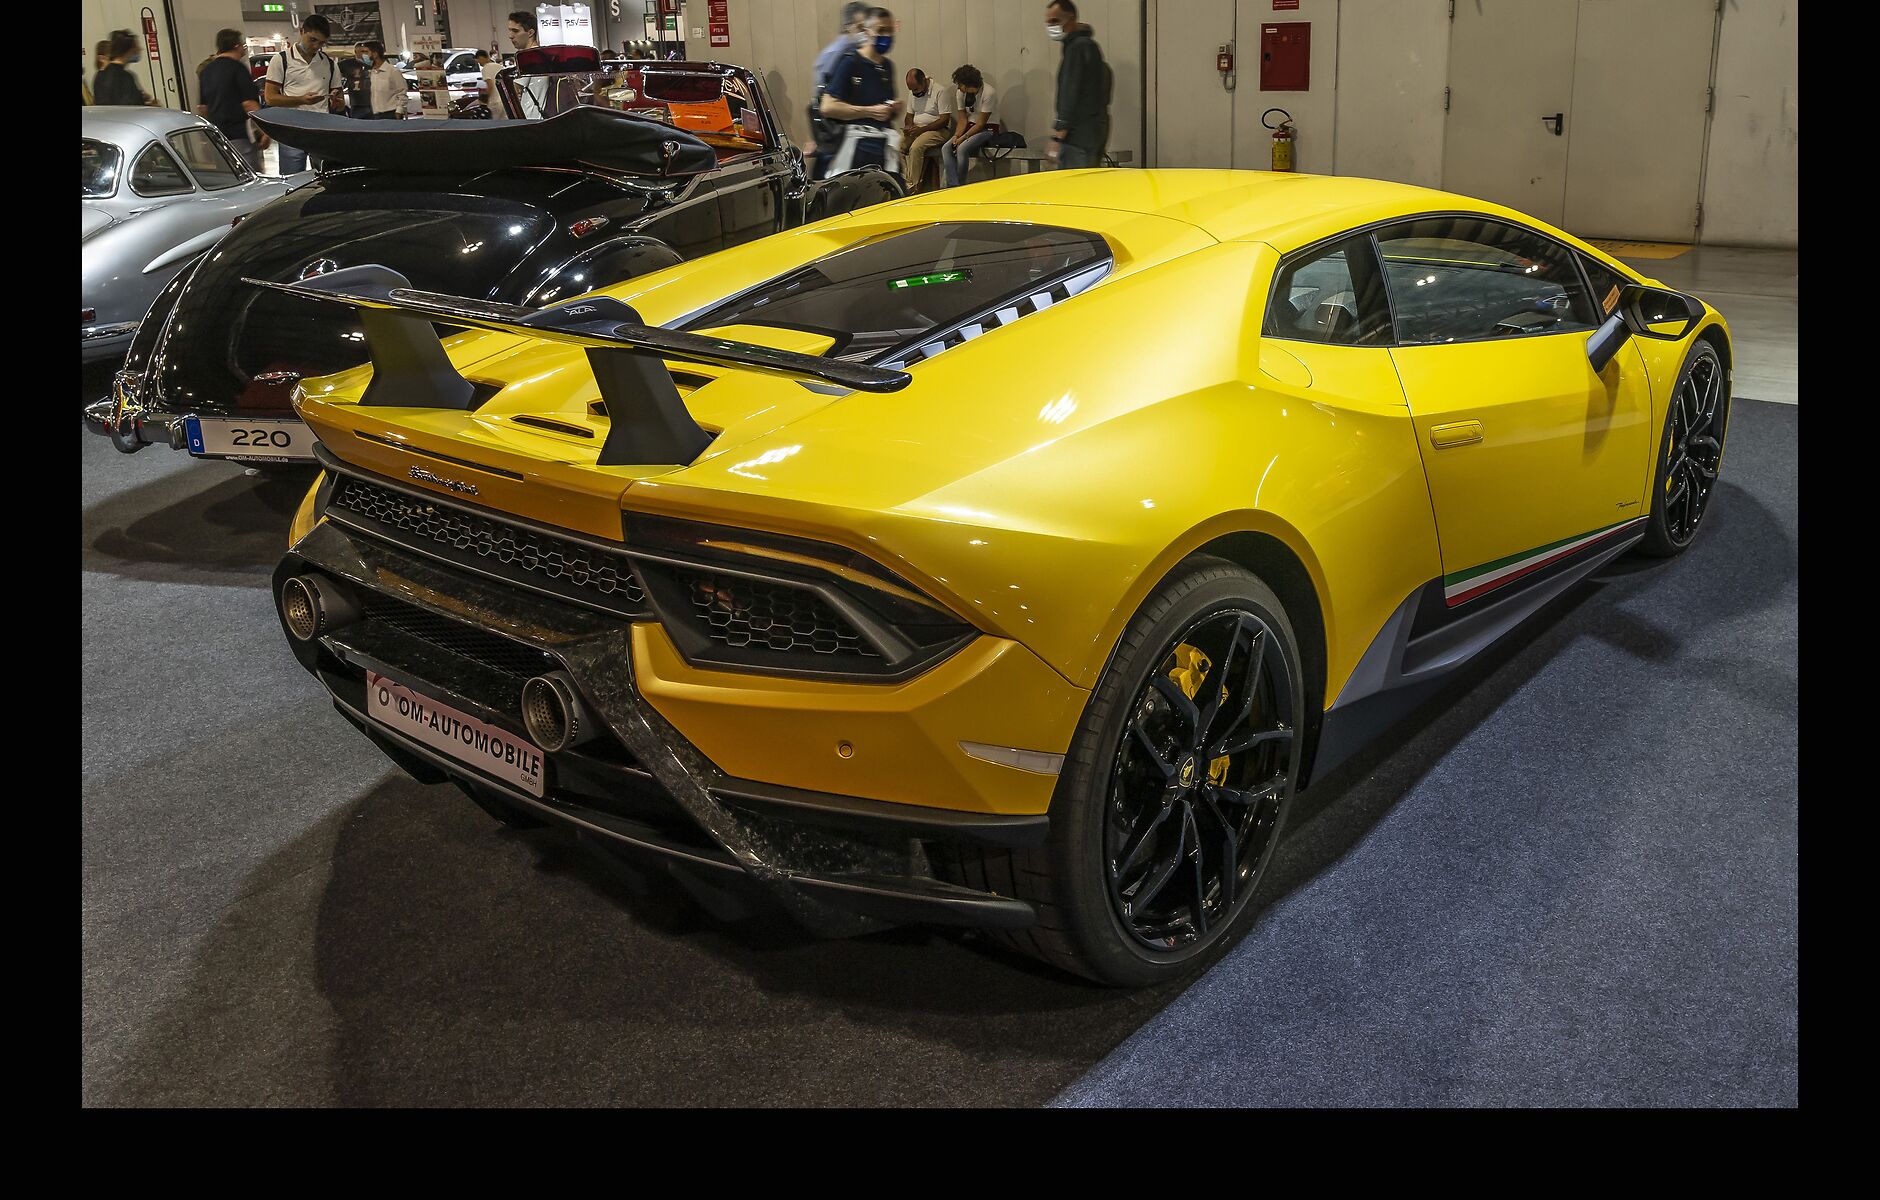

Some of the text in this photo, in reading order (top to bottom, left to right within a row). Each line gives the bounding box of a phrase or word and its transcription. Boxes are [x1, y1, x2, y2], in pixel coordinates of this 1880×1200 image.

[414, 4, 423, 20] T
[193, 428, 291, 448] D 220
